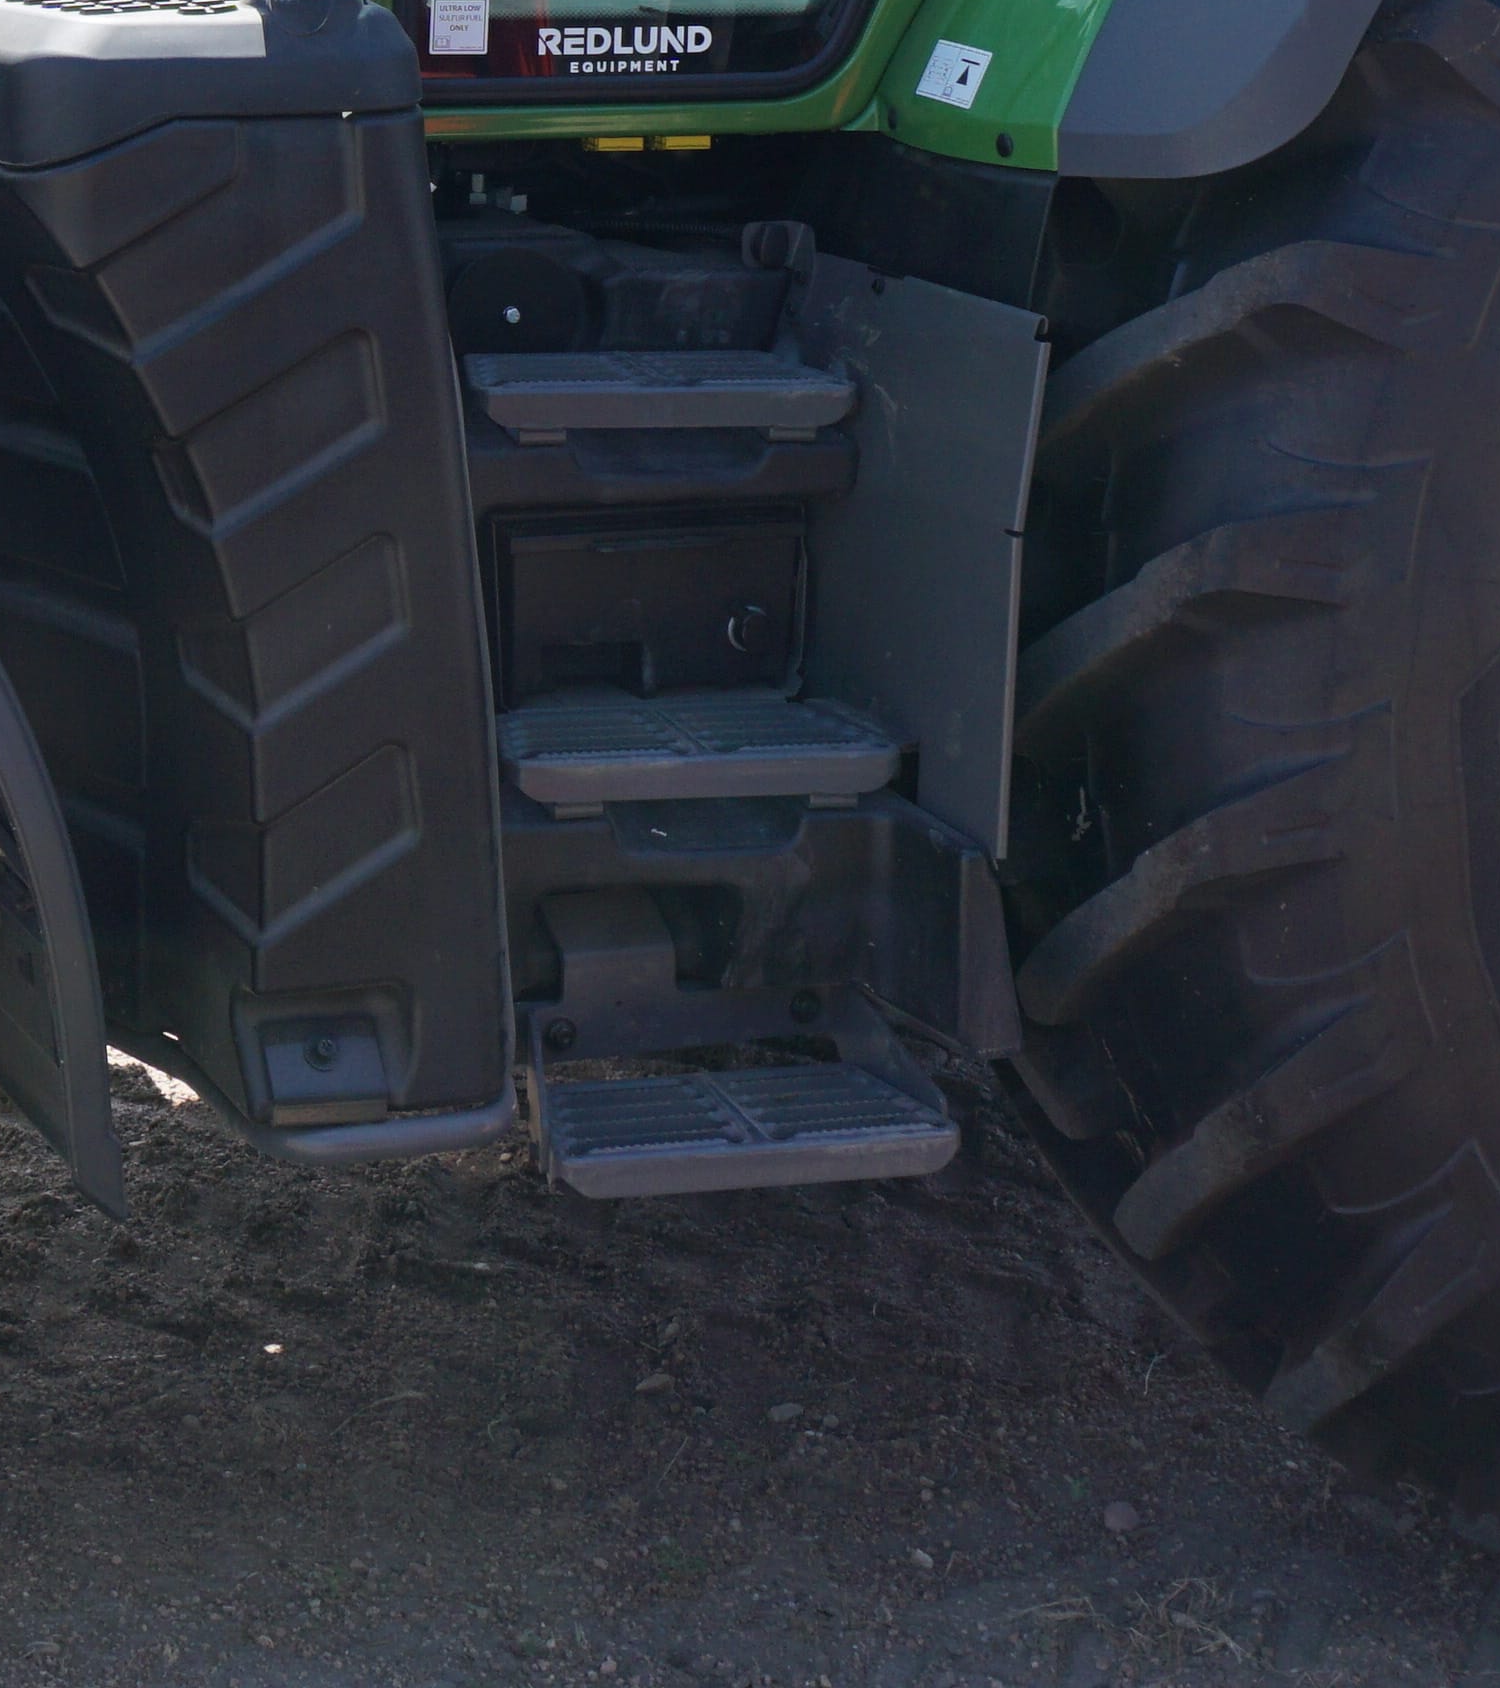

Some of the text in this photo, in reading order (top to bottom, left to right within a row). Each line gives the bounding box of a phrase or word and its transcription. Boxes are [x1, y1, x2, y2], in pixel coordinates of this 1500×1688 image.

[440, 4, 481, 12] ULTRA LOW
[449, 24, 470, 32] ONLY
[538, 25, 712, 57] REDLUND
[570, 59, 680, 73] EQUIPMENT
